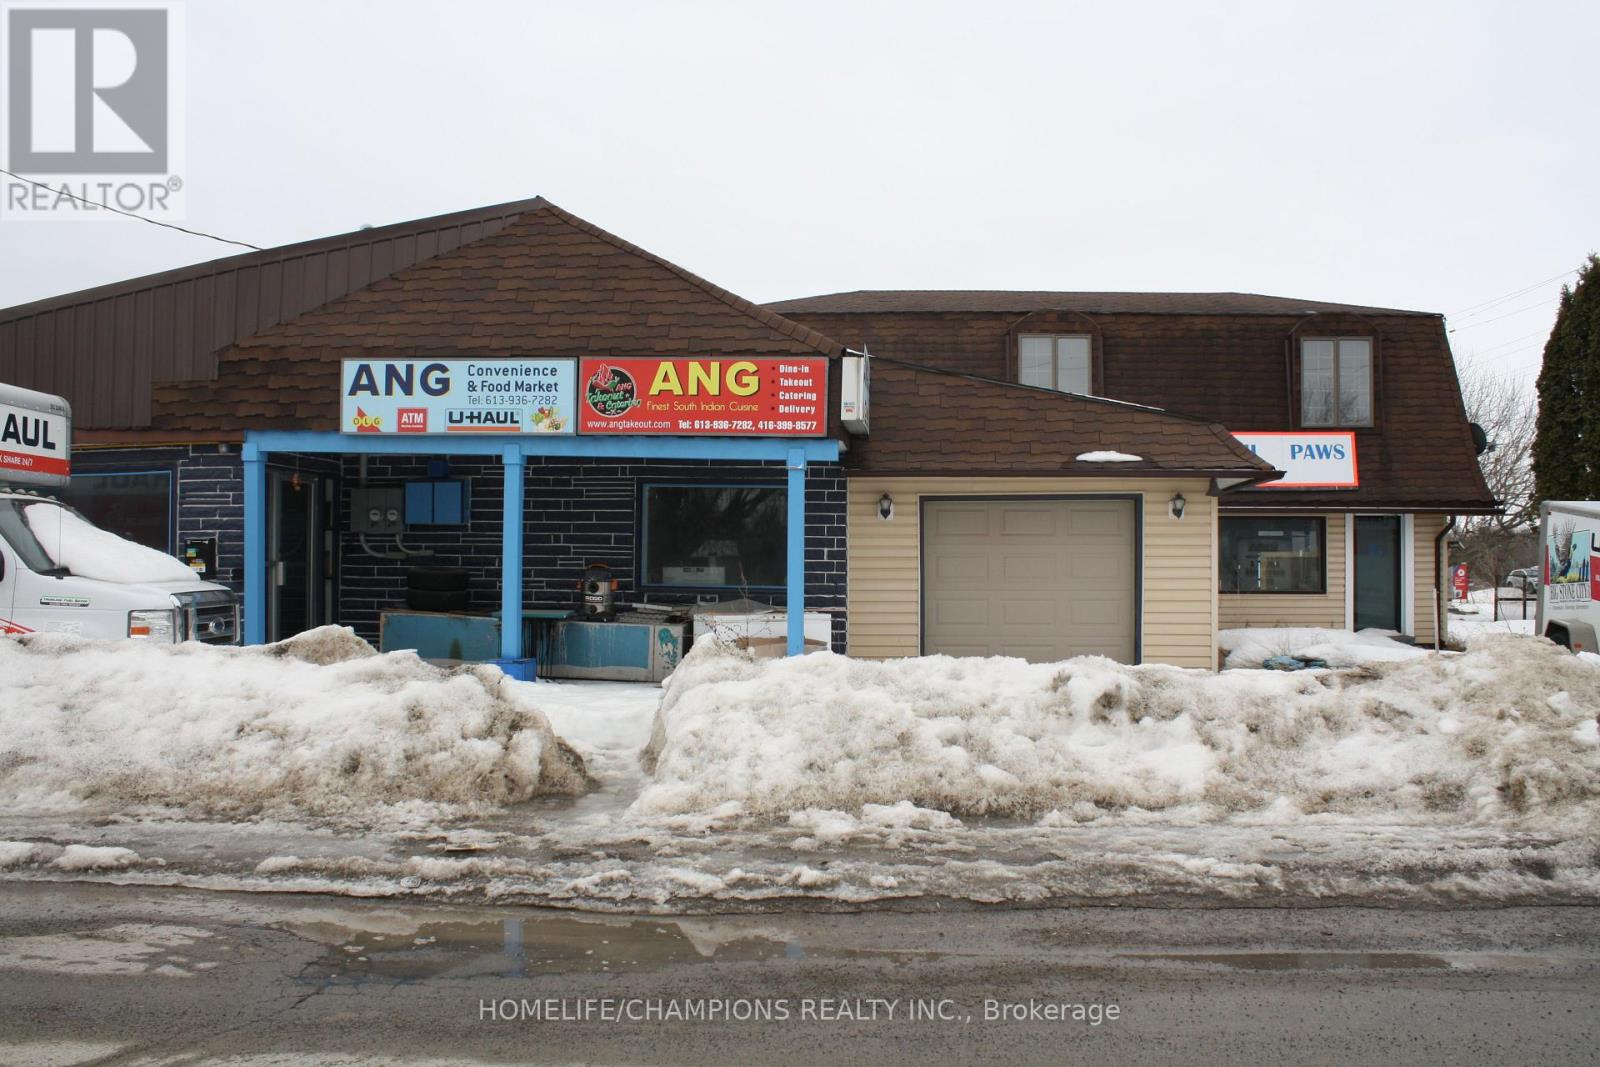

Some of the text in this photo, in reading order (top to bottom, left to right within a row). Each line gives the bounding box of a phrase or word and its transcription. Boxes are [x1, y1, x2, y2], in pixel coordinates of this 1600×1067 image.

[468, 364, 558, 377] Convenience
[779, 364, 809, 374] Dine-in
[348, 363, 450, 396] ANG
[648, 361, 760, 397] ANG
[779, 378, 813, 387] Takeout
[468, 380, 559, 393] & Food Market
[485, 395, 558, 406] 613-936-7282
[779, 391, 817, 401] Catering
[647, 400, 759, 412] Finest South Indian Cuisine
[779, 405, 816, 415] Delivery
[353, 417, 381, 426] OLG
[401, 412, 424, 425] ATM
[448, 411, 520, 424] U-HAUL
[587, 419, 671, 430] www.angtakeout.com
[678, 420, 692, 429] Tel:
[1290, 444, 1345, 460] PAWS
[3, 455, 21, 465] SHARE
